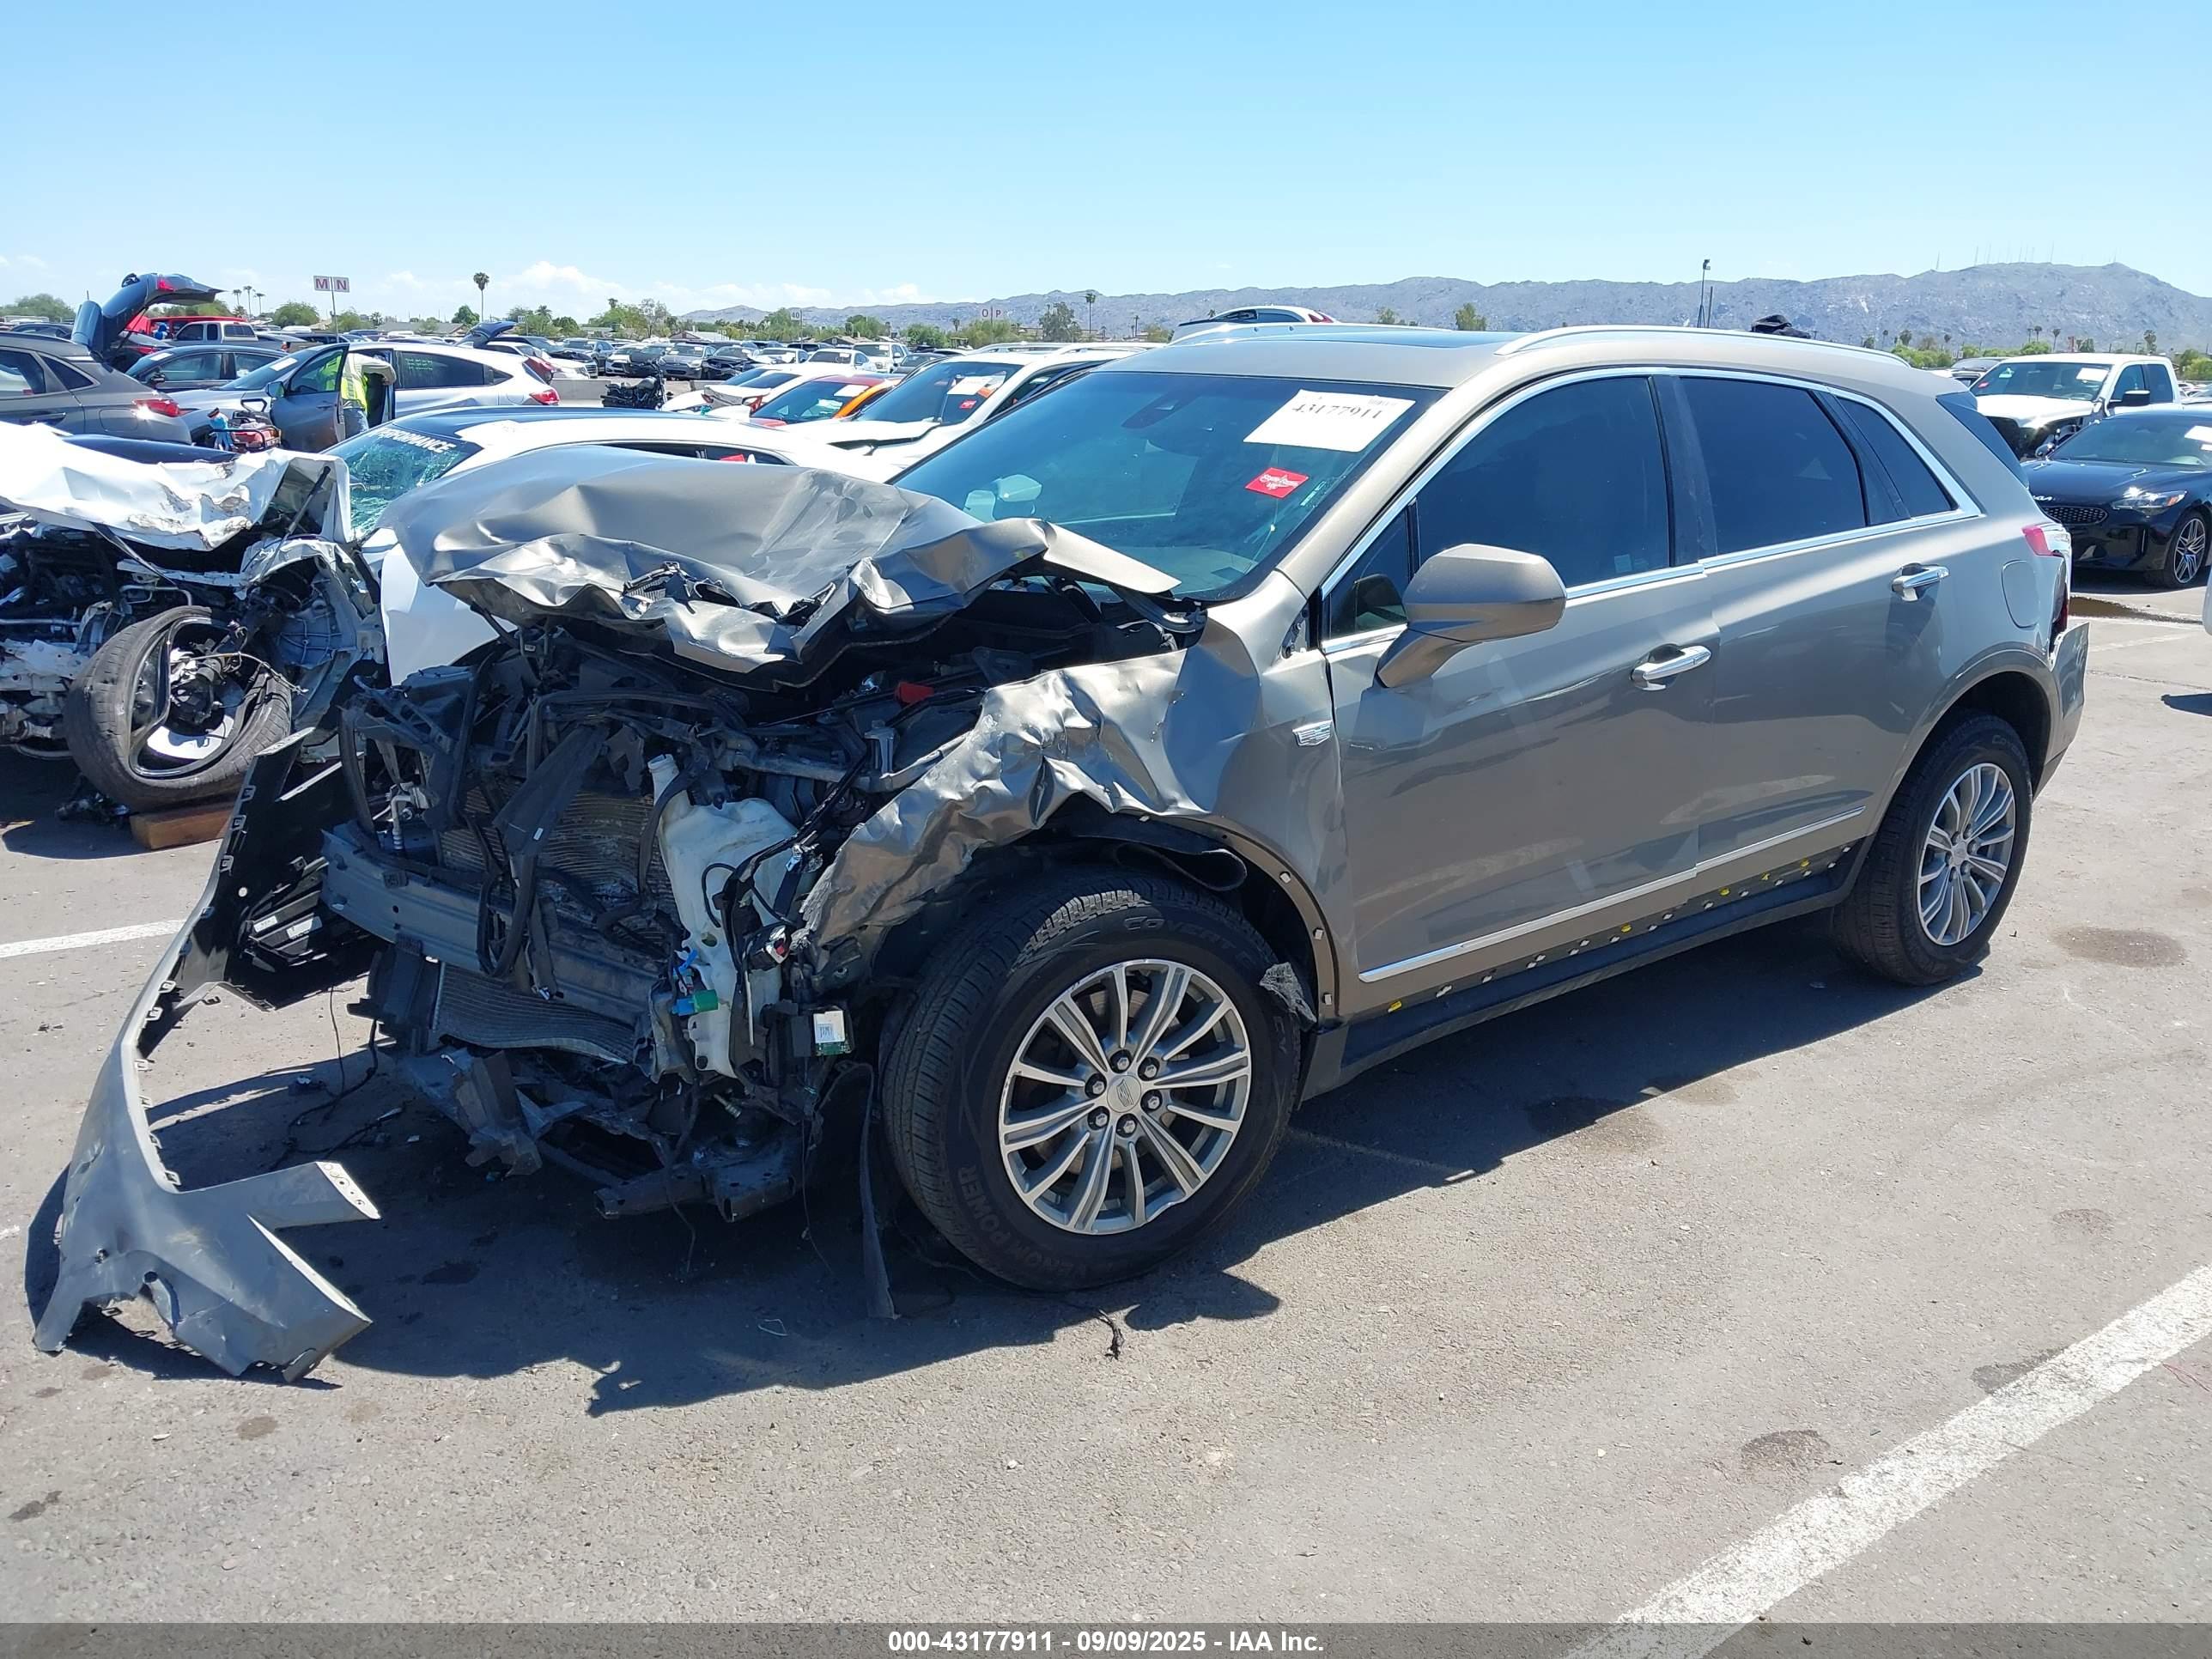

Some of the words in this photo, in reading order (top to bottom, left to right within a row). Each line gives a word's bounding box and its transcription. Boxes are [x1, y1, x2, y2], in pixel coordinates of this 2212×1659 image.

[315, 278, 328, 289] M
[336, 279, 347, 290] N
[995, 309, 1002, 318] P
[957, 1164, 1012, 1246] POWER
